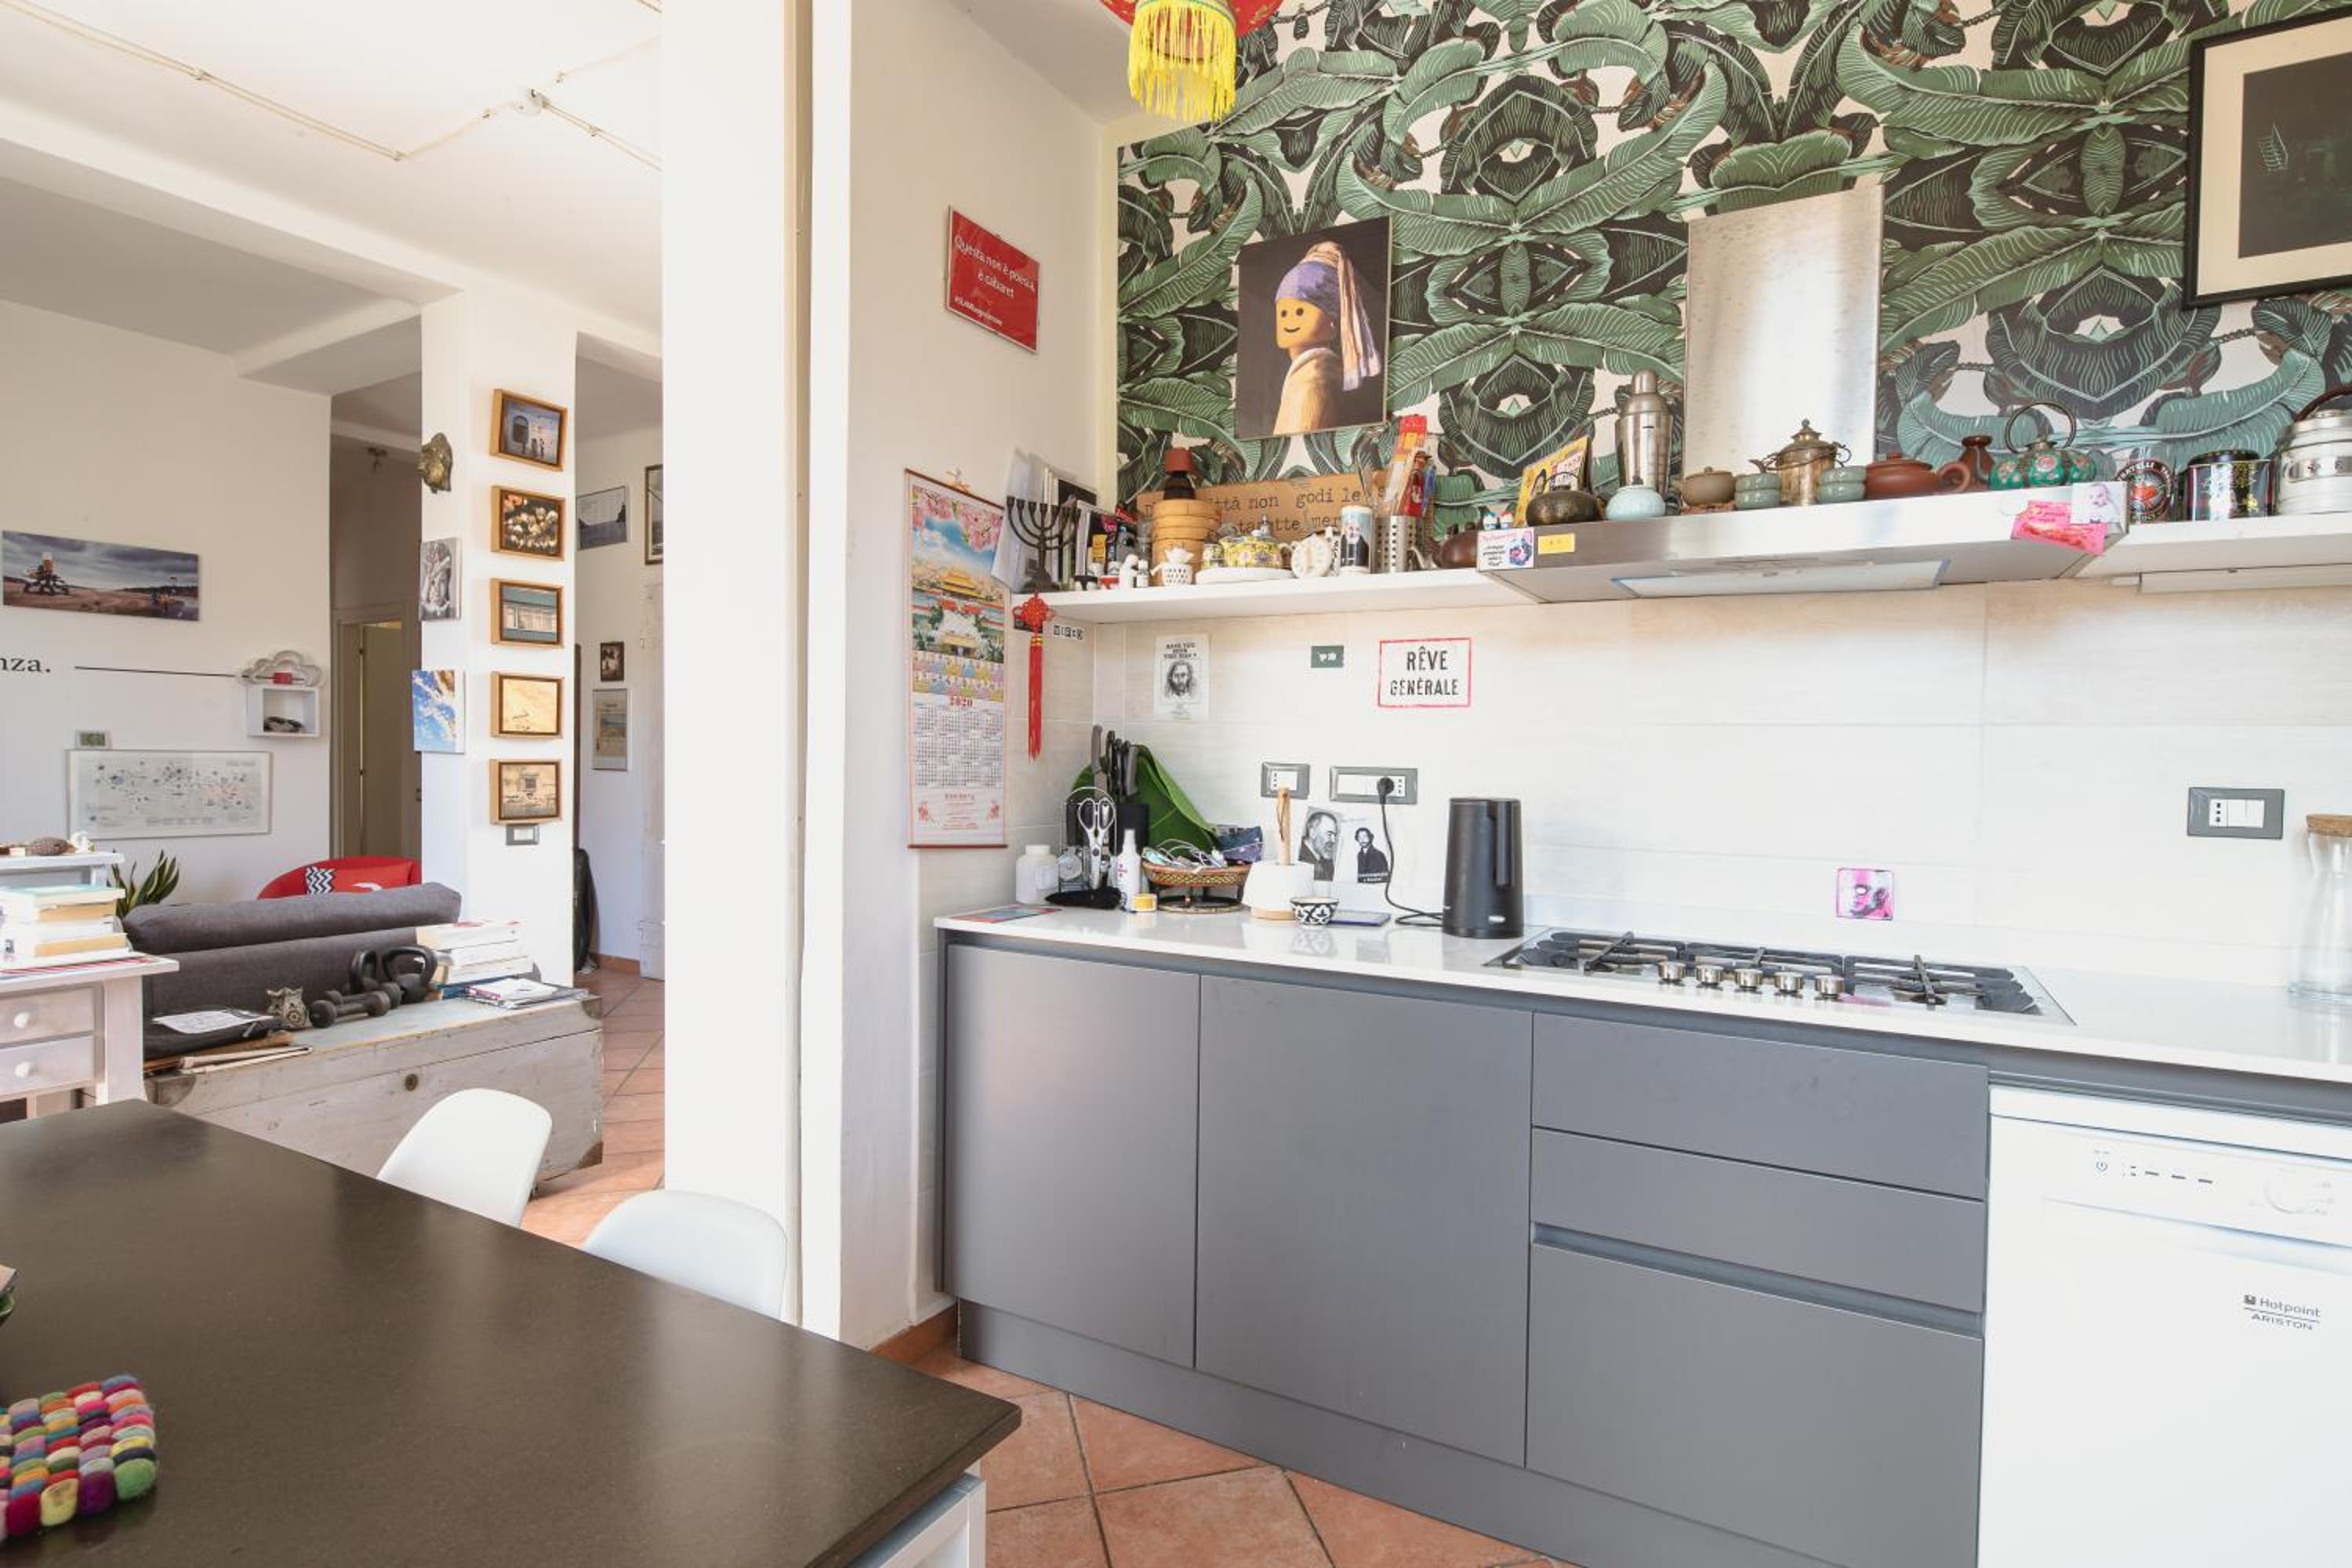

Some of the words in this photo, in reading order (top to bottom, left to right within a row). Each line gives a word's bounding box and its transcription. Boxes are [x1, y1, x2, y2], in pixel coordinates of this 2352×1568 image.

[953, 235, 987, 263] Questa
[986, 256, 1002, 272] non
[1248, 494, 1279, 510] non
[1296, 487, 1334, 509] godi
[1406, 645, 1449, 671] RÊVE
[1390, 677, 1460, 695] GÉNÉRALE
[949, 696, 974, 706] 2020
[2260, 1298, 2321, 1318] Hotpoint
[2251, 1313, 2313, 1330] ARISTON
